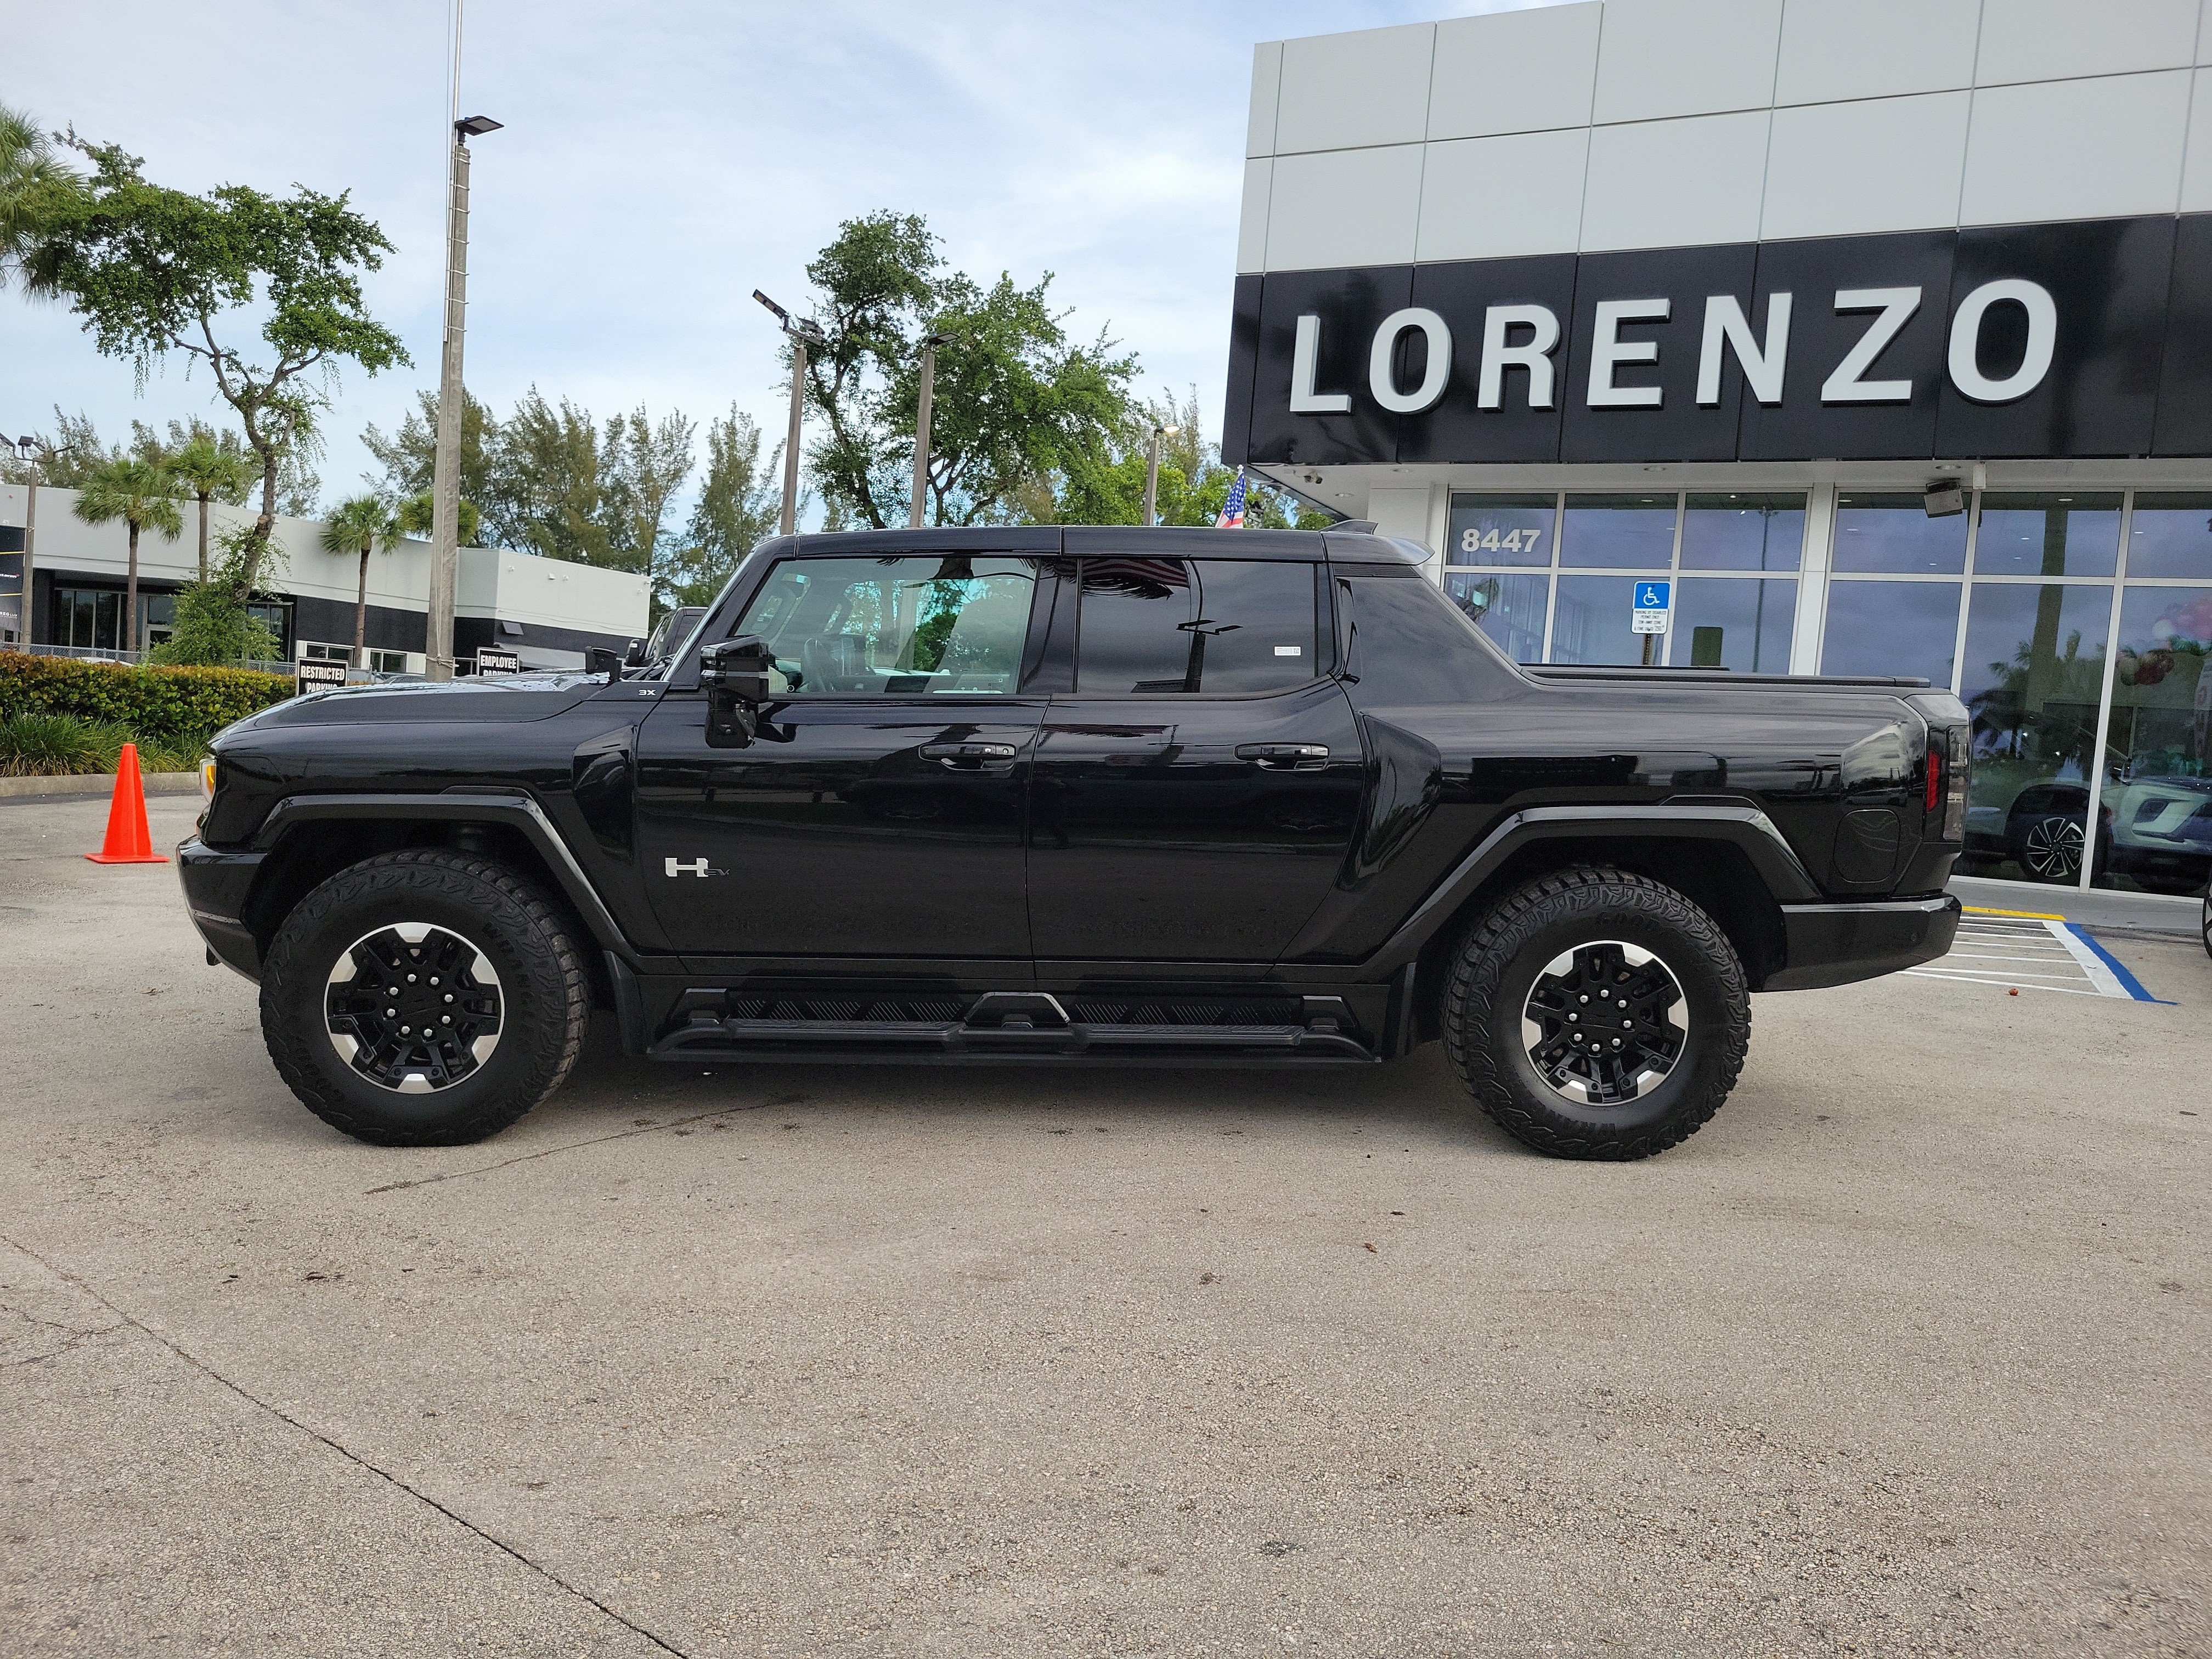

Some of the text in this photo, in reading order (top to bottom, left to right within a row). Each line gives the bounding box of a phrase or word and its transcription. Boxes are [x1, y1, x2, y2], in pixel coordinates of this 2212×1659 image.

[1289, 278, 2058, 414] LORENZO
[1461, 528, 1541, 552] 8447
[480, 654, 517, 669] EMPLOYEE
[300, 665, 345, 681] RESTRICTED
